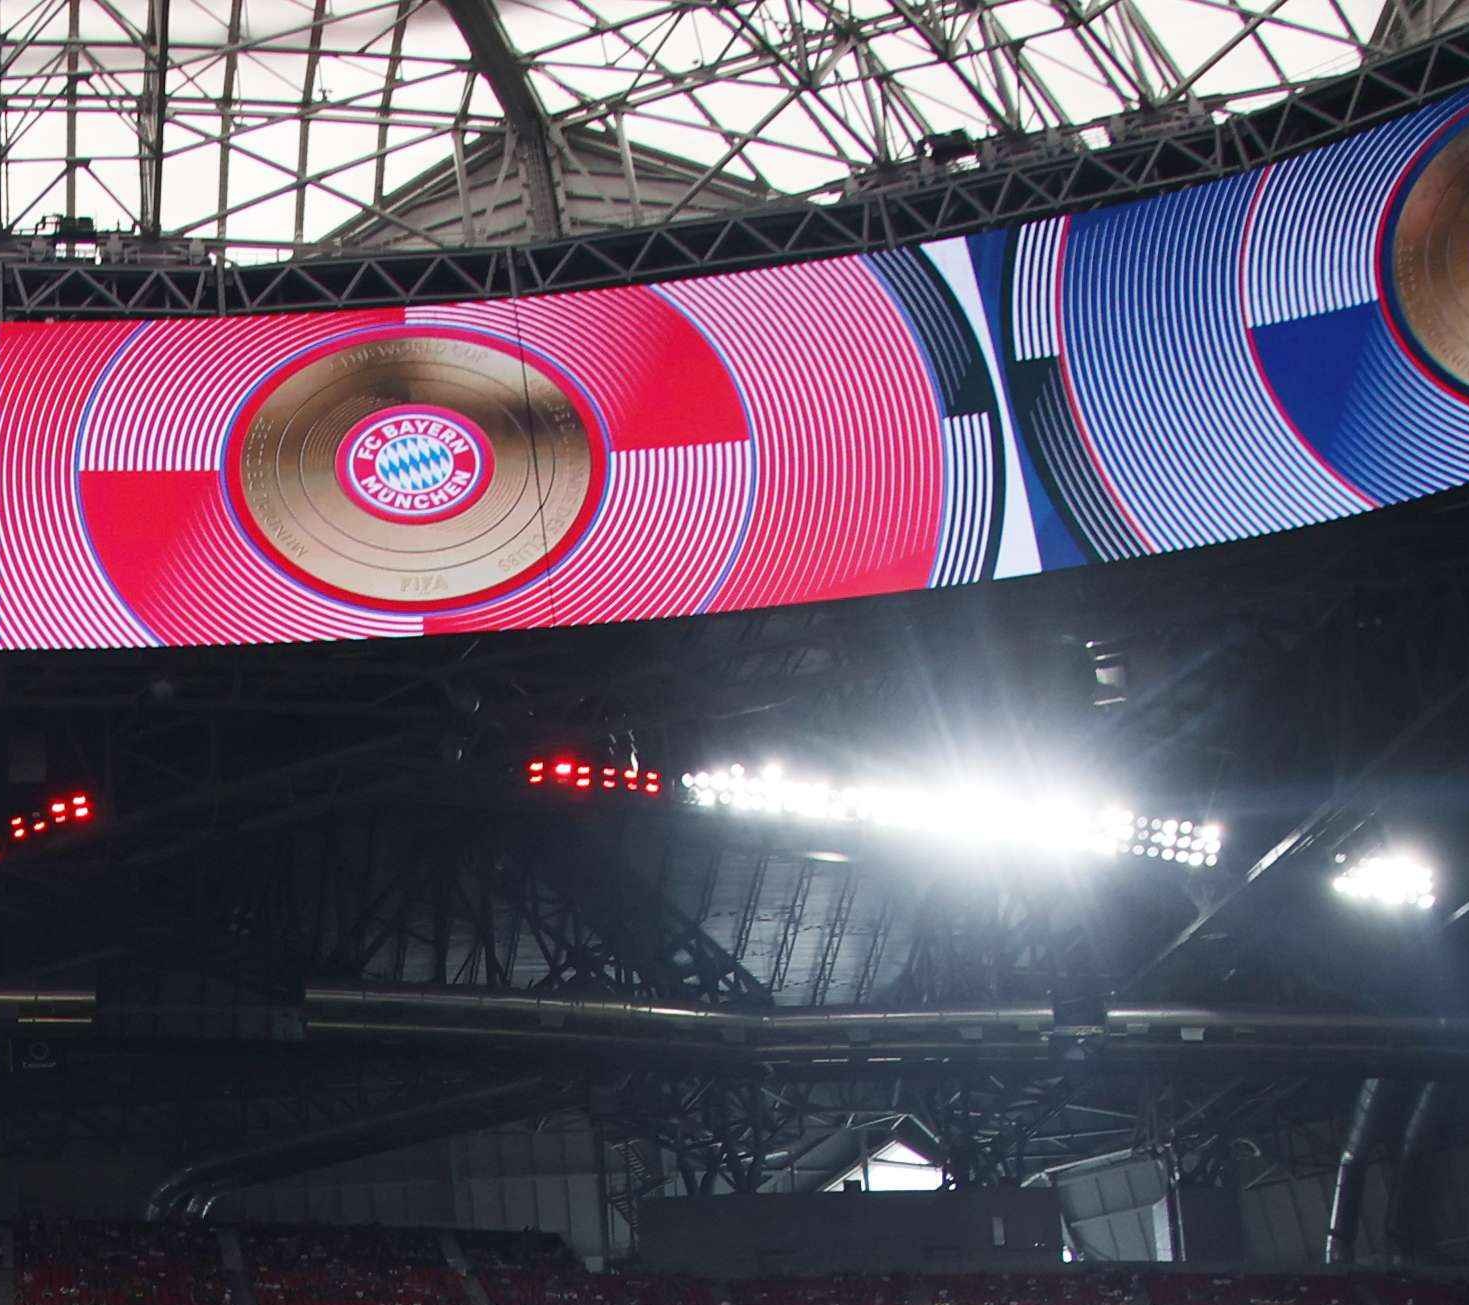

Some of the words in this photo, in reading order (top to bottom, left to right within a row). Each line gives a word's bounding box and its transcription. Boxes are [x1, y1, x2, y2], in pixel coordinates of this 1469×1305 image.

[357, 433, 383, 460] FC
[382, 420, 469, 456] BAYERN
[360, 469, 471, 510] MÜNCHEN
